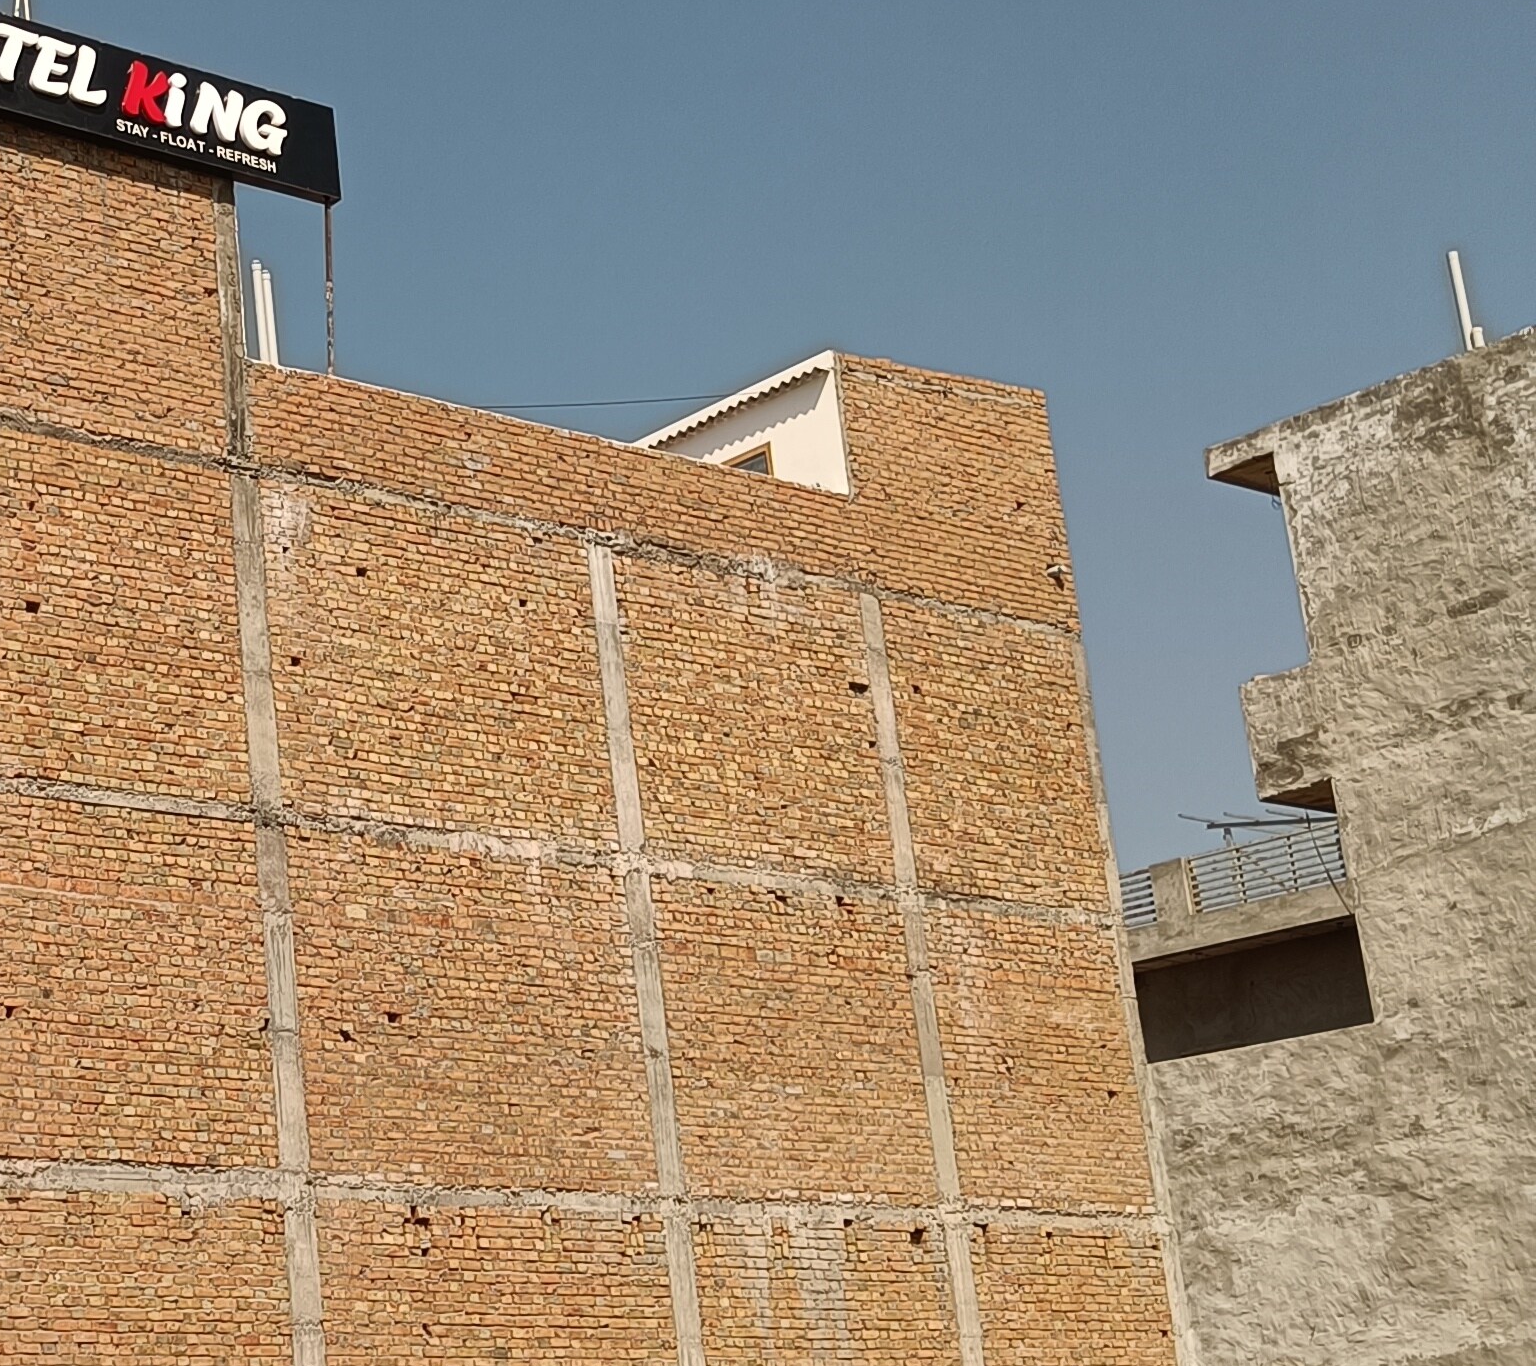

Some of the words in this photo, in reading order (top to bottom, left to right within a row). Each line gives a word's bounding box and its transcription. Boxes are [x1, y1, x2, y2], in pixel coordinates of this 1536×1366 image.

[116, 118, 149, 139] STAY
[160, 131, 206, 154] FLOAT
[216, 145, 277, 173] REFRESH
